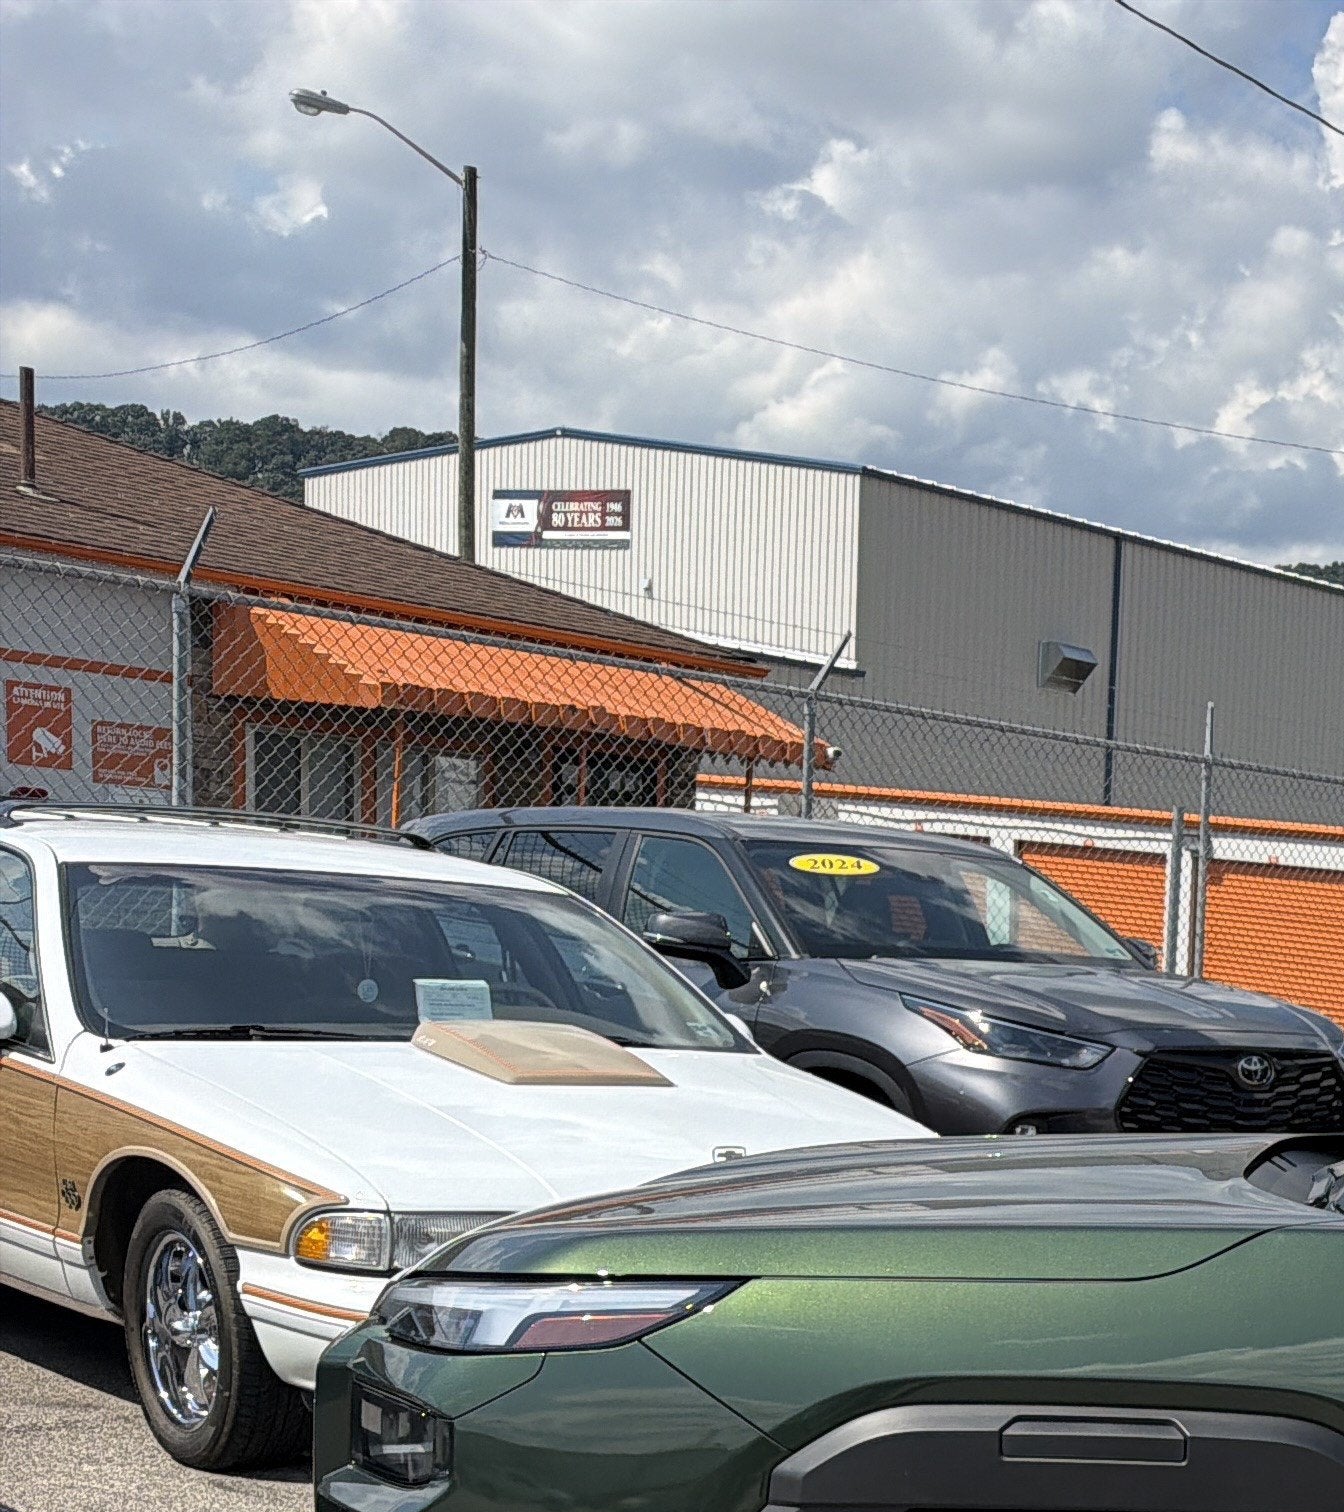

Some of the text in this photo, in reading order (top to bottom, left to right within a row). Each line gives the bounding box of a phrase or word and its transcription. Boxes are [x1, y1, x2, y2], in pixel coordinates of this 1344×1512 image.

[551, 501, 603, 512] CELEBRATING
[551, 512, 566, 528] 80
[566, 512, 602, 528] YEARS
[12, 686, 65, 702] ATTENTION
[807, 858, 864, 870] 2024
